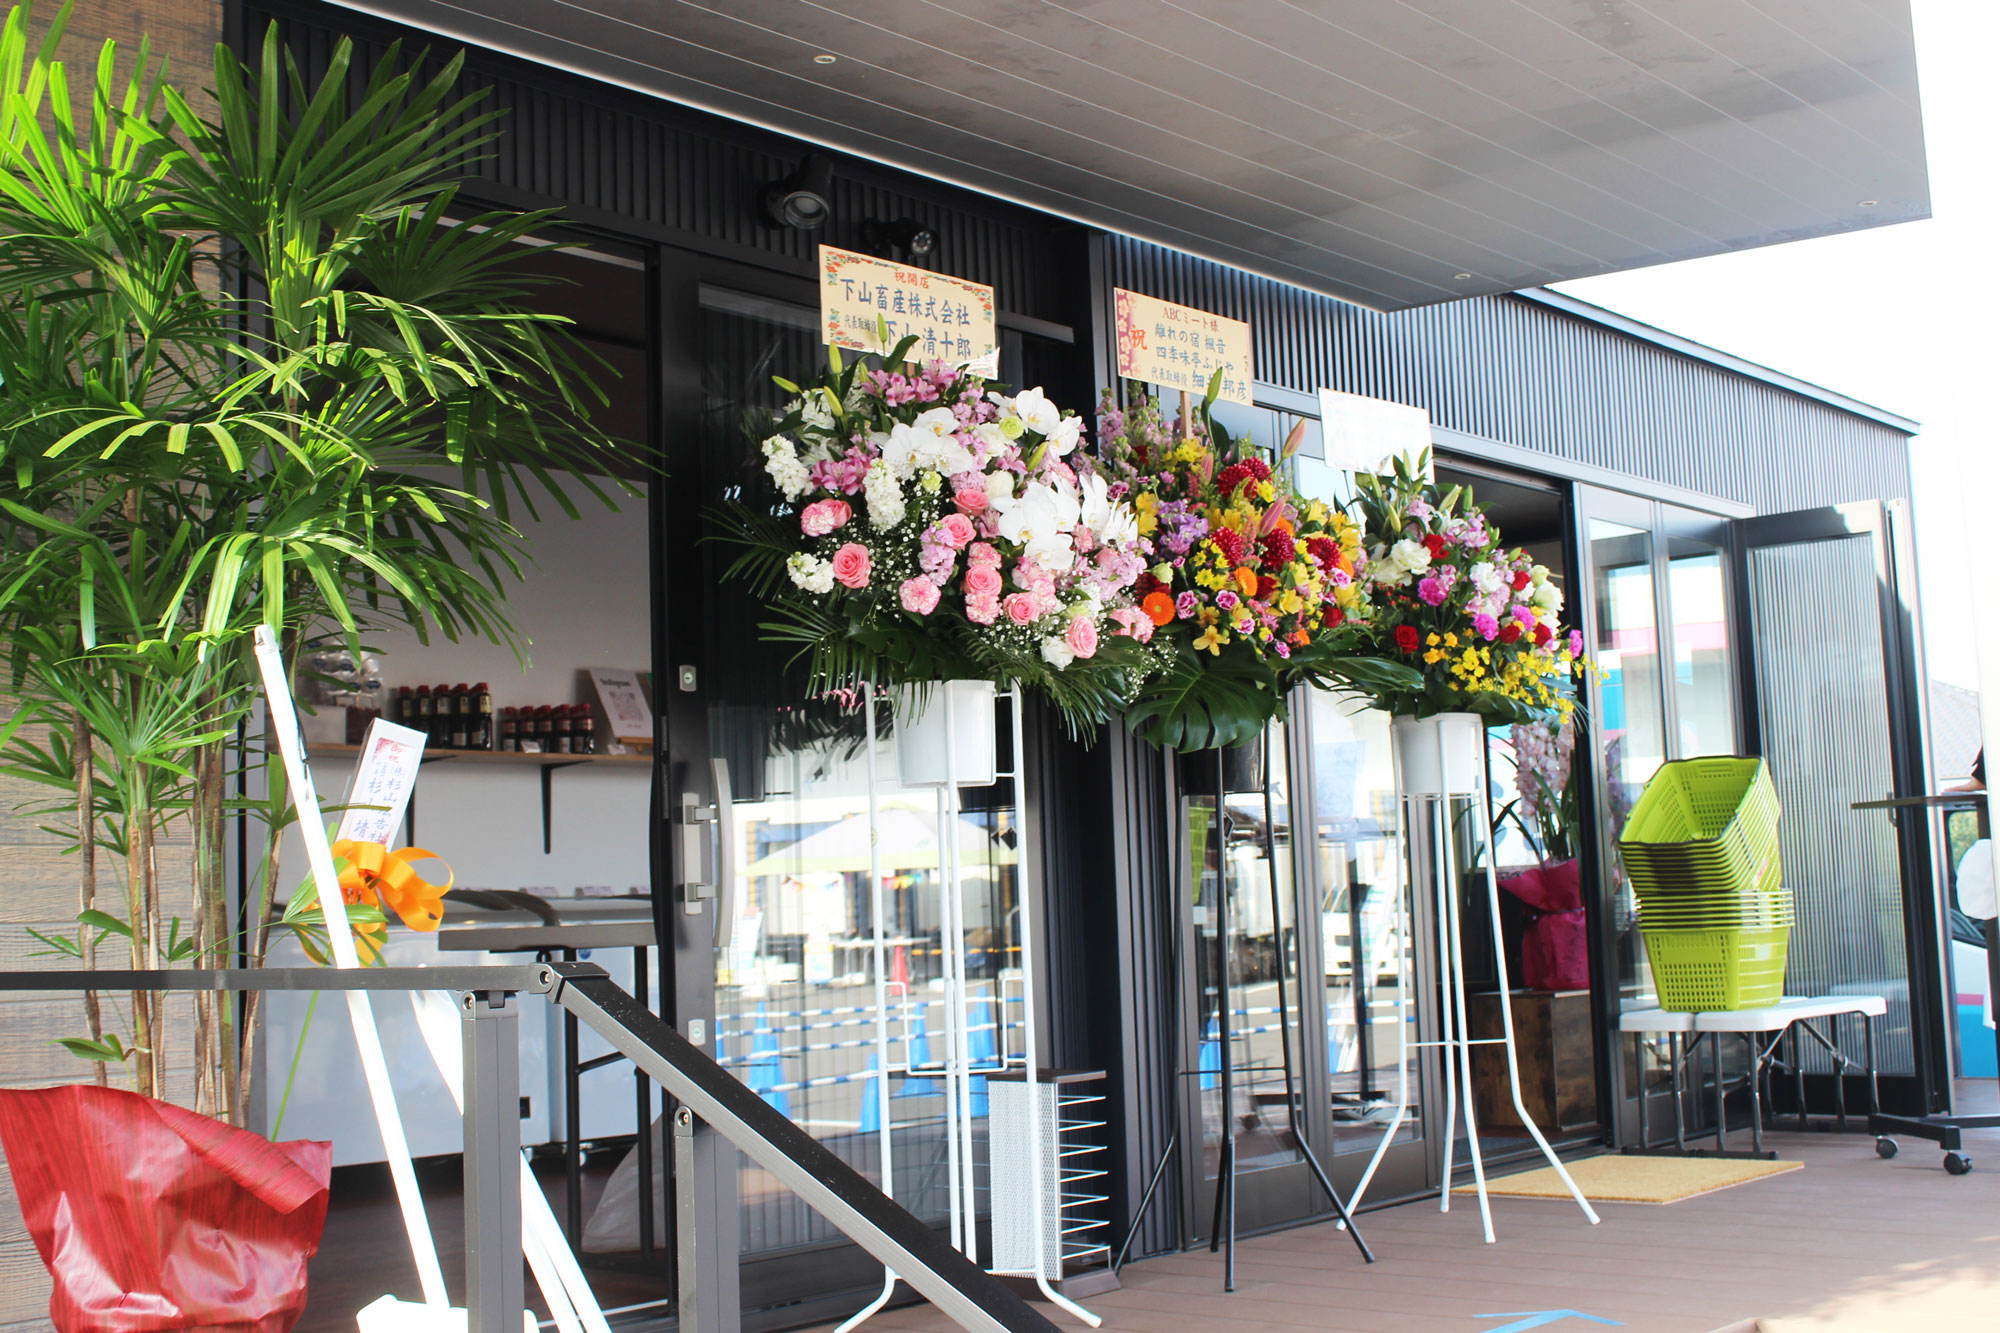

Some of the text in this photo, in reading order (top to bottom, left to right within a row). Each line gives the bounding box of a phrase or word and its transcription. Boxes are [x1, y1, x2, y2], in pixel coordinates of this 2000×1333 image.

[894, 271, 930, 289] 祝開店
[840, 278, 971, 327] 下山畜産株式会社
[1162, 307, 1220, 333] ABCミート様
[1129, 325, 1148, 351] 祝
